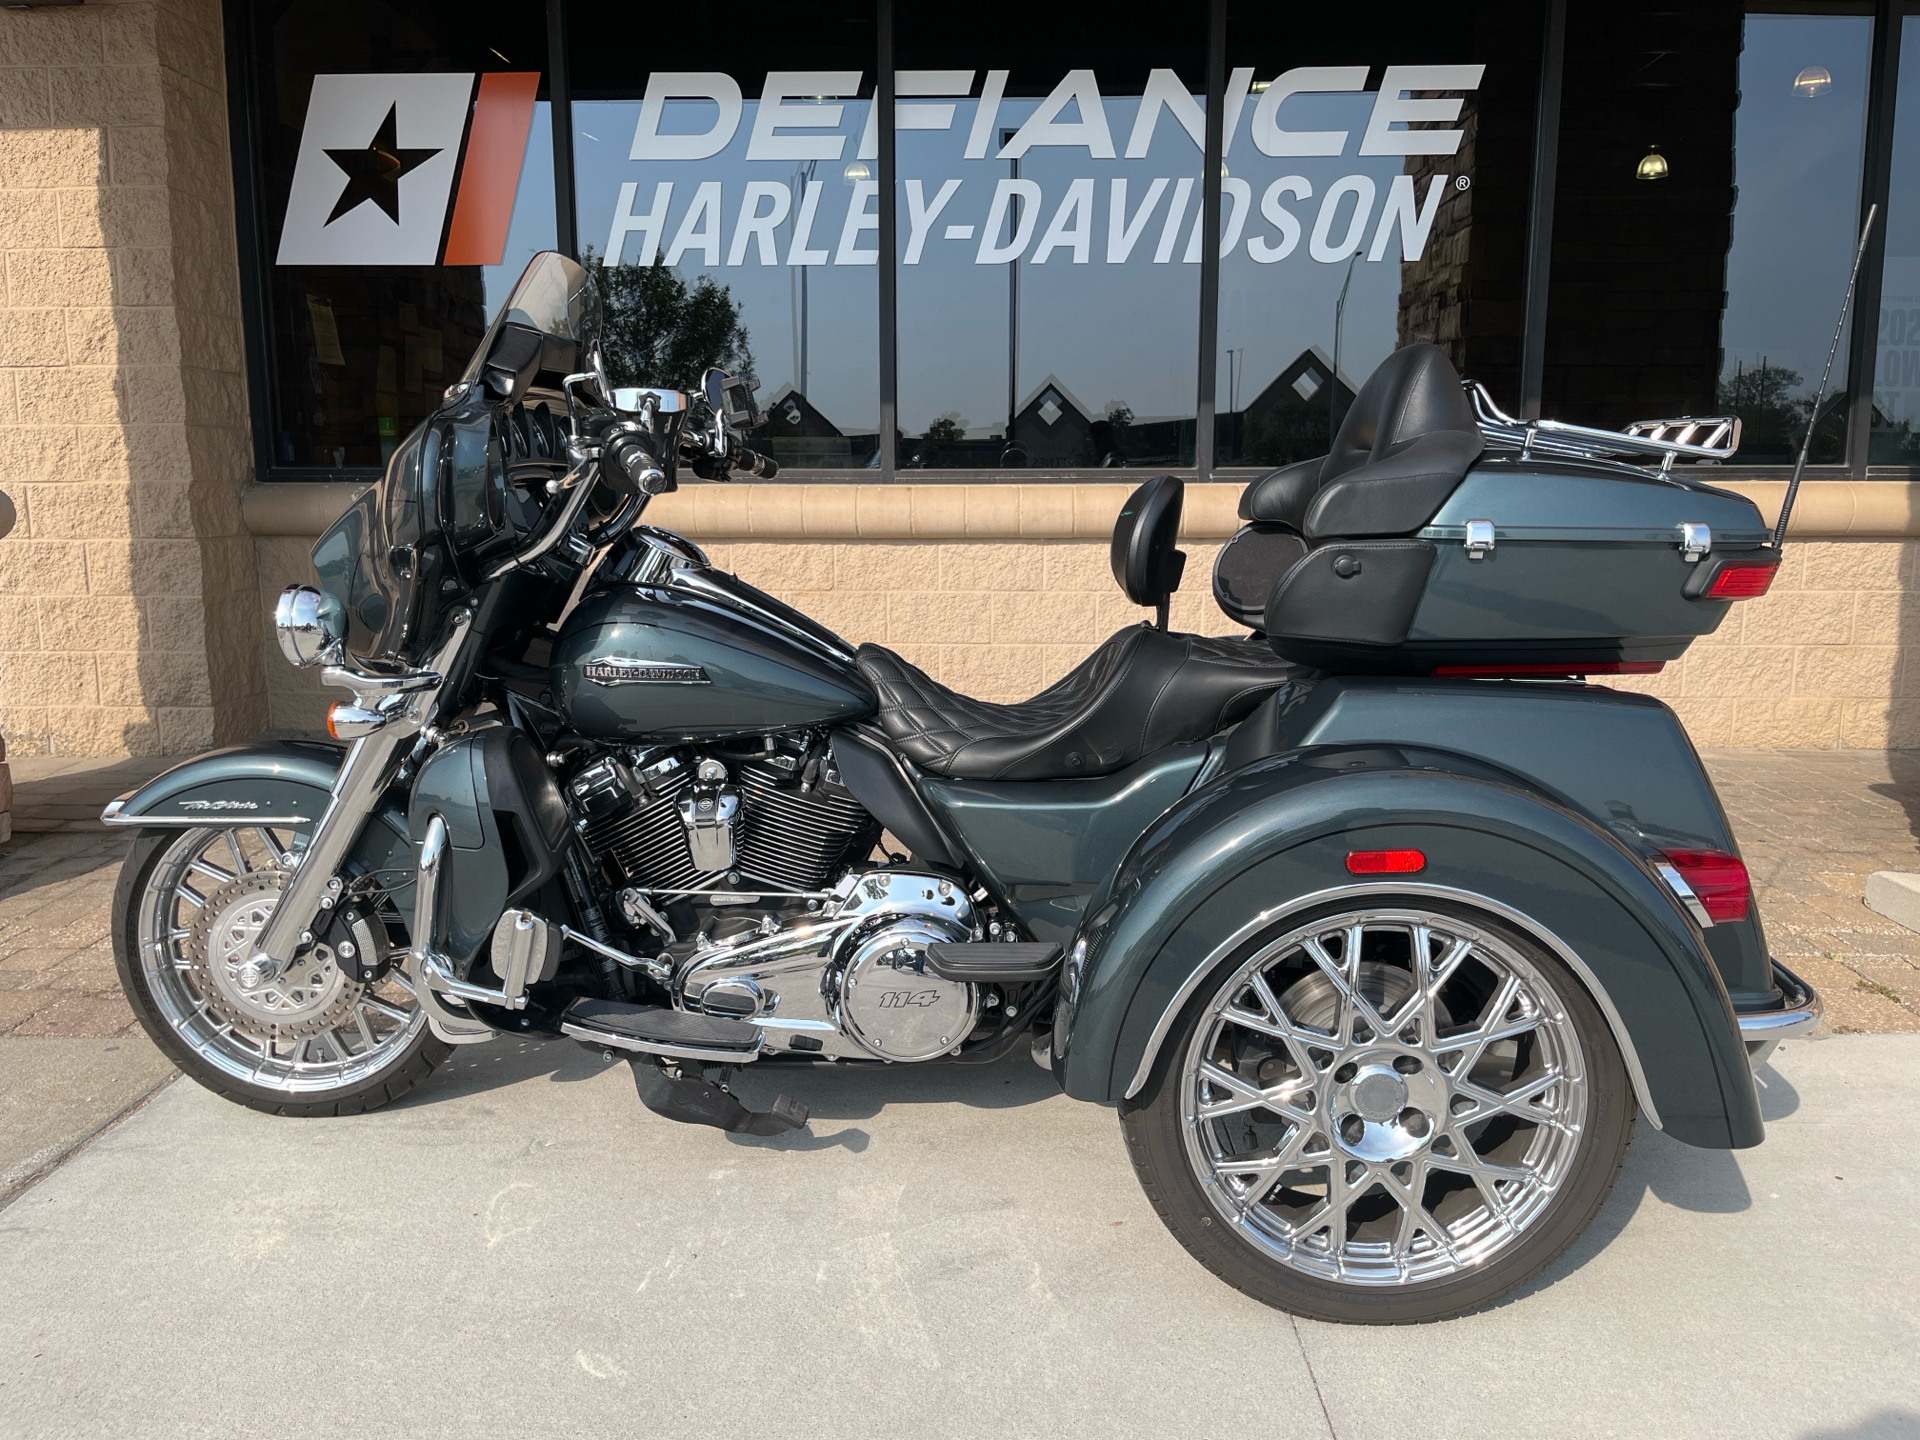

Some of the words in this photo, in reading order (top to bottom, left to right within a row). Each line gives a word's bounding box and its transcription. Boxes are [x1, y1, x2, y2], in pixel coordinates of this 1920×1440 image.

[629, 64, 1486, 161] DEFIANCE
[602, 174, 1449, 267] HARLEY-DAVIDSON
[586, 666, 700, 680] HARLEY-DAVIDSON
[879, 990, 940, 1008] 114
